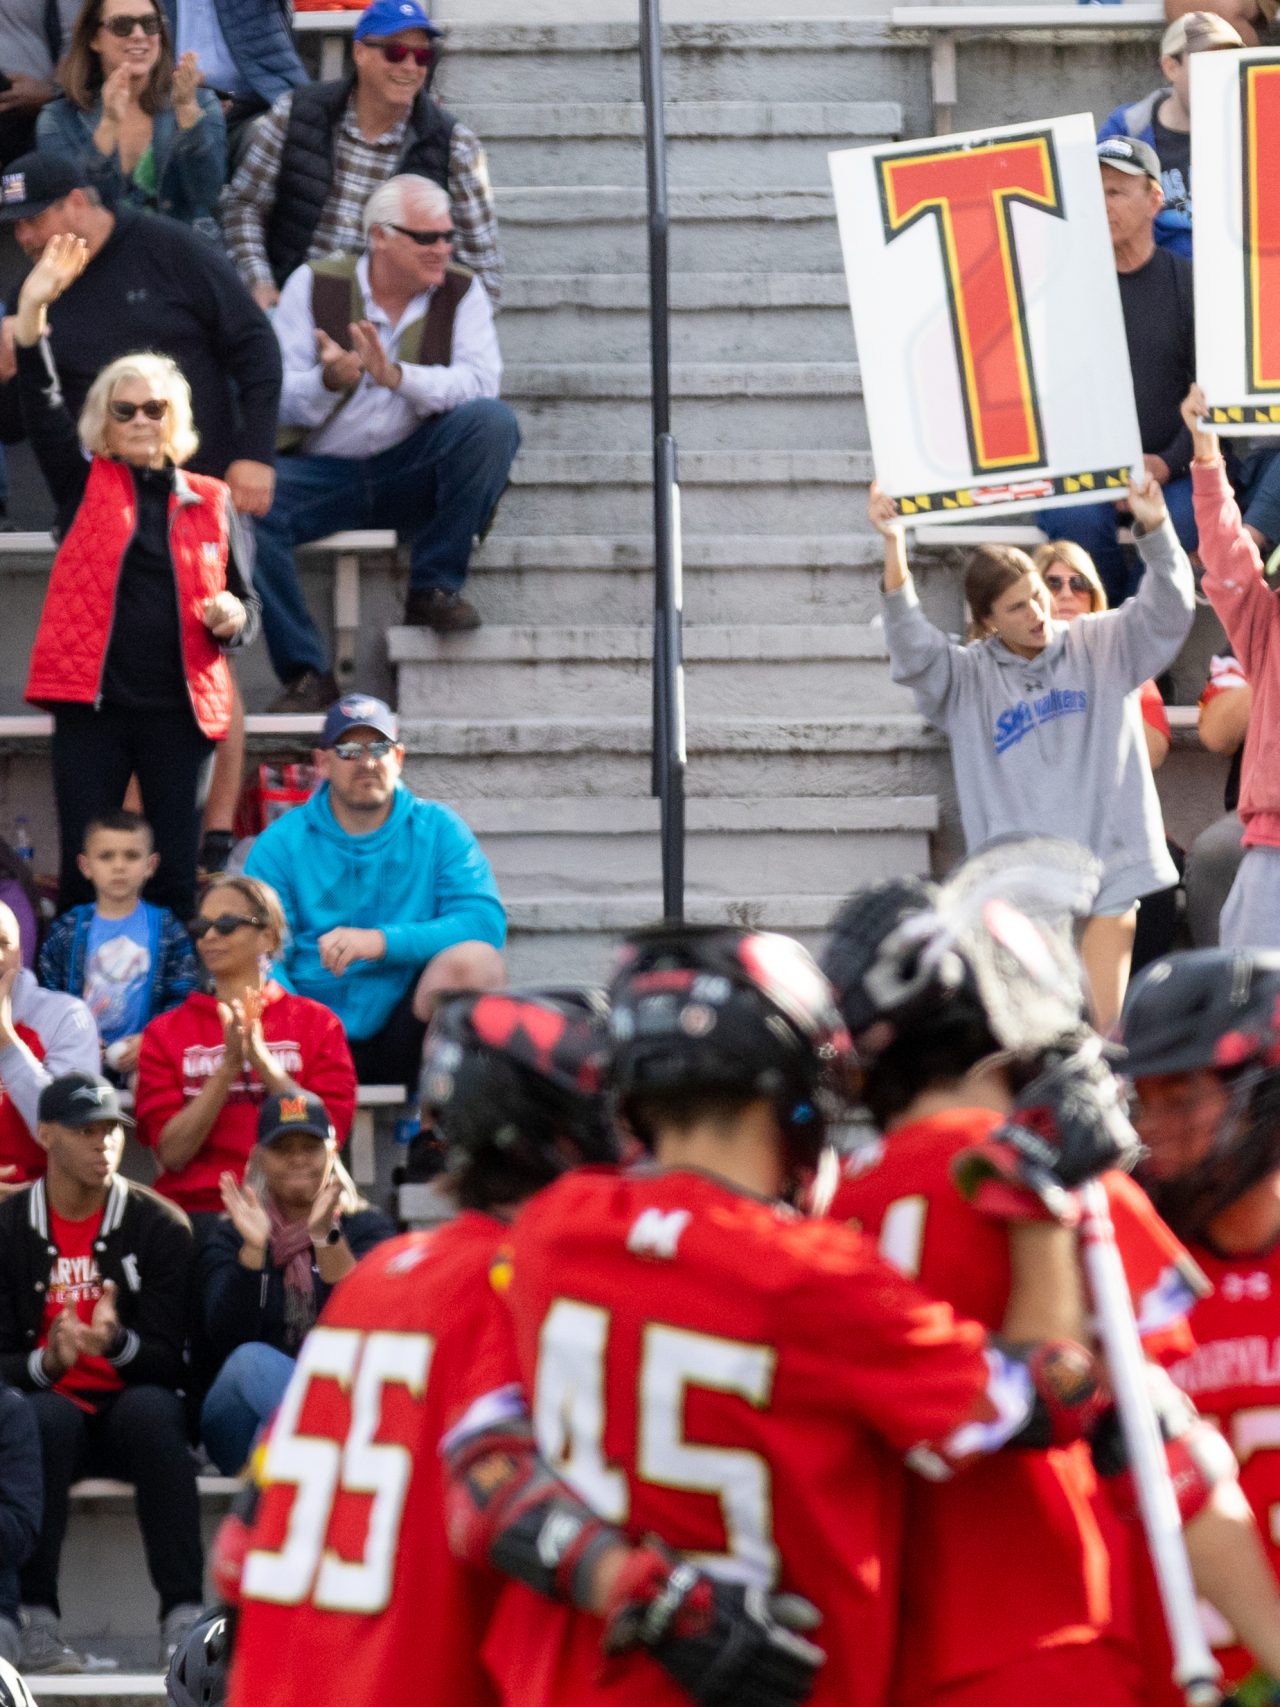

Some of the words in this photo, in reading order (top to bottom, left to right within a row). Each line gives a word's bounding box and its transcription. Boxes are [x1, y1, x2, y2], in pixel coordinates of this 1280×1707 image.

[625, 1207, 693, 1259] M
[241, 1326, 434, 1615] 55
[532, 1297, 778, 1592] 45
